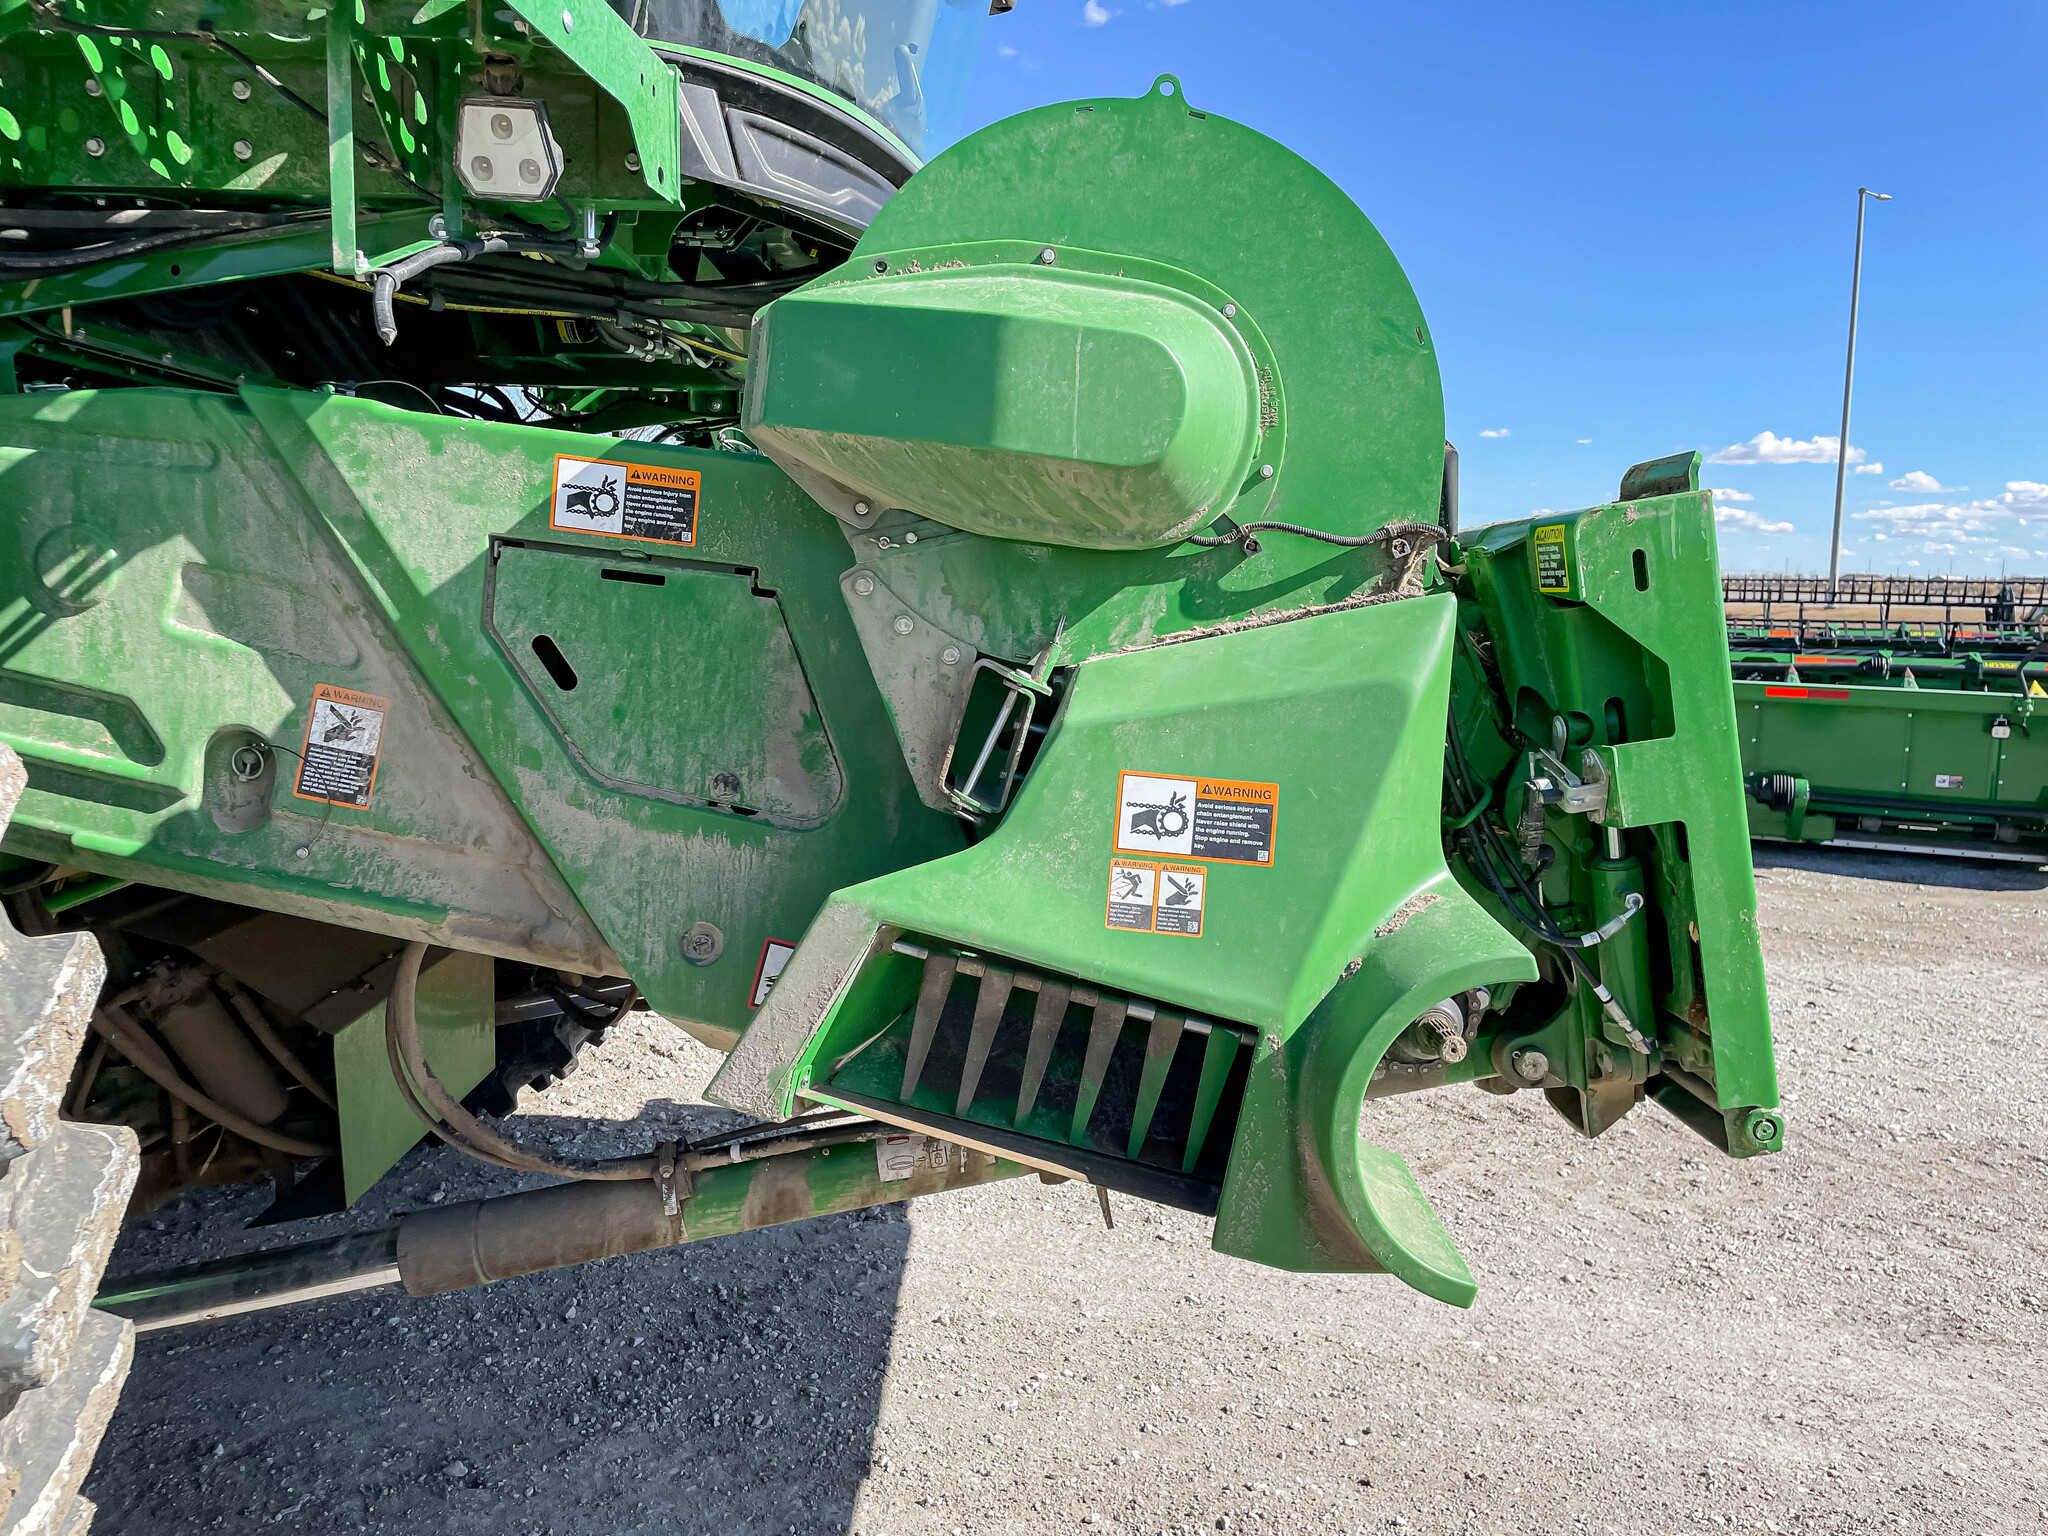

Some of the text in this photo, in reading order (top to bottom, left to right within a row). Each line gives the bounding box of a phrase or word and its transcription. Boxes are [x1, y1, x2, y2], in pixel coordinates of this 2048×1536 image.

[642, 472, 694, 485] WARNING
[1540, 528, 1563, 540] CAUTION
[334, 690, 384, 707] WARNING
[1214, 786, 1271, 799] WARNING
[1122, 860, 1152, 868] WARNING
